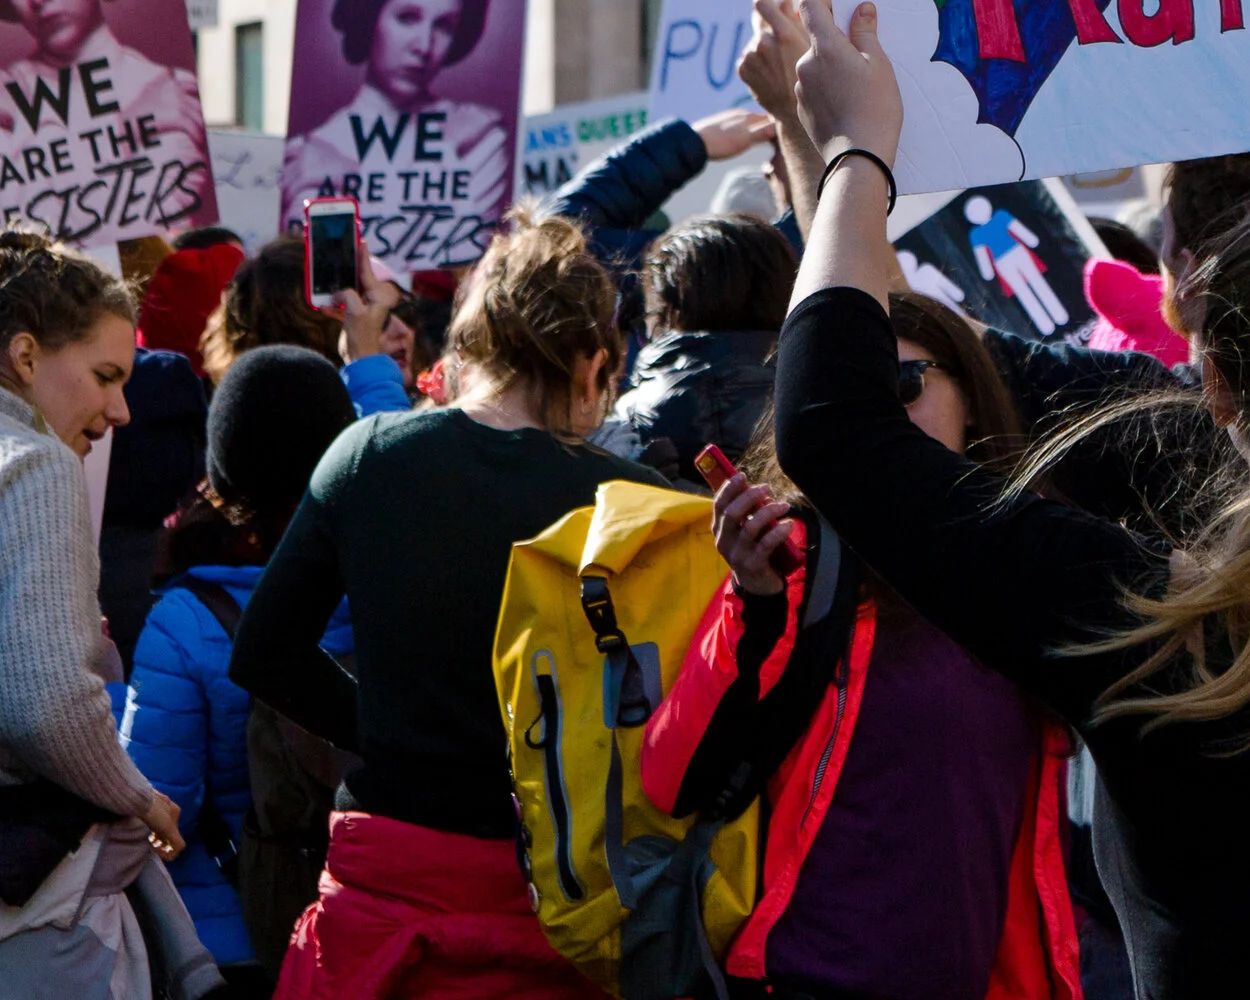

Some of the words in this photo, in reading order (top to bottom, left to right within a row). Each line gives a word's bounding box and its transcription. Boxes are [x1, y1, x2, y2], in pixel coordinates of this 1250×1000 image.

[5, 56, 120, 134] WE
[0, 138, 74, 190] ARE
[79, 113, 162, 164] THE
[348, 112, 447, 163] WE
[317, 171, 387, 203] ARE
[397, 169, 472, 202] THE
